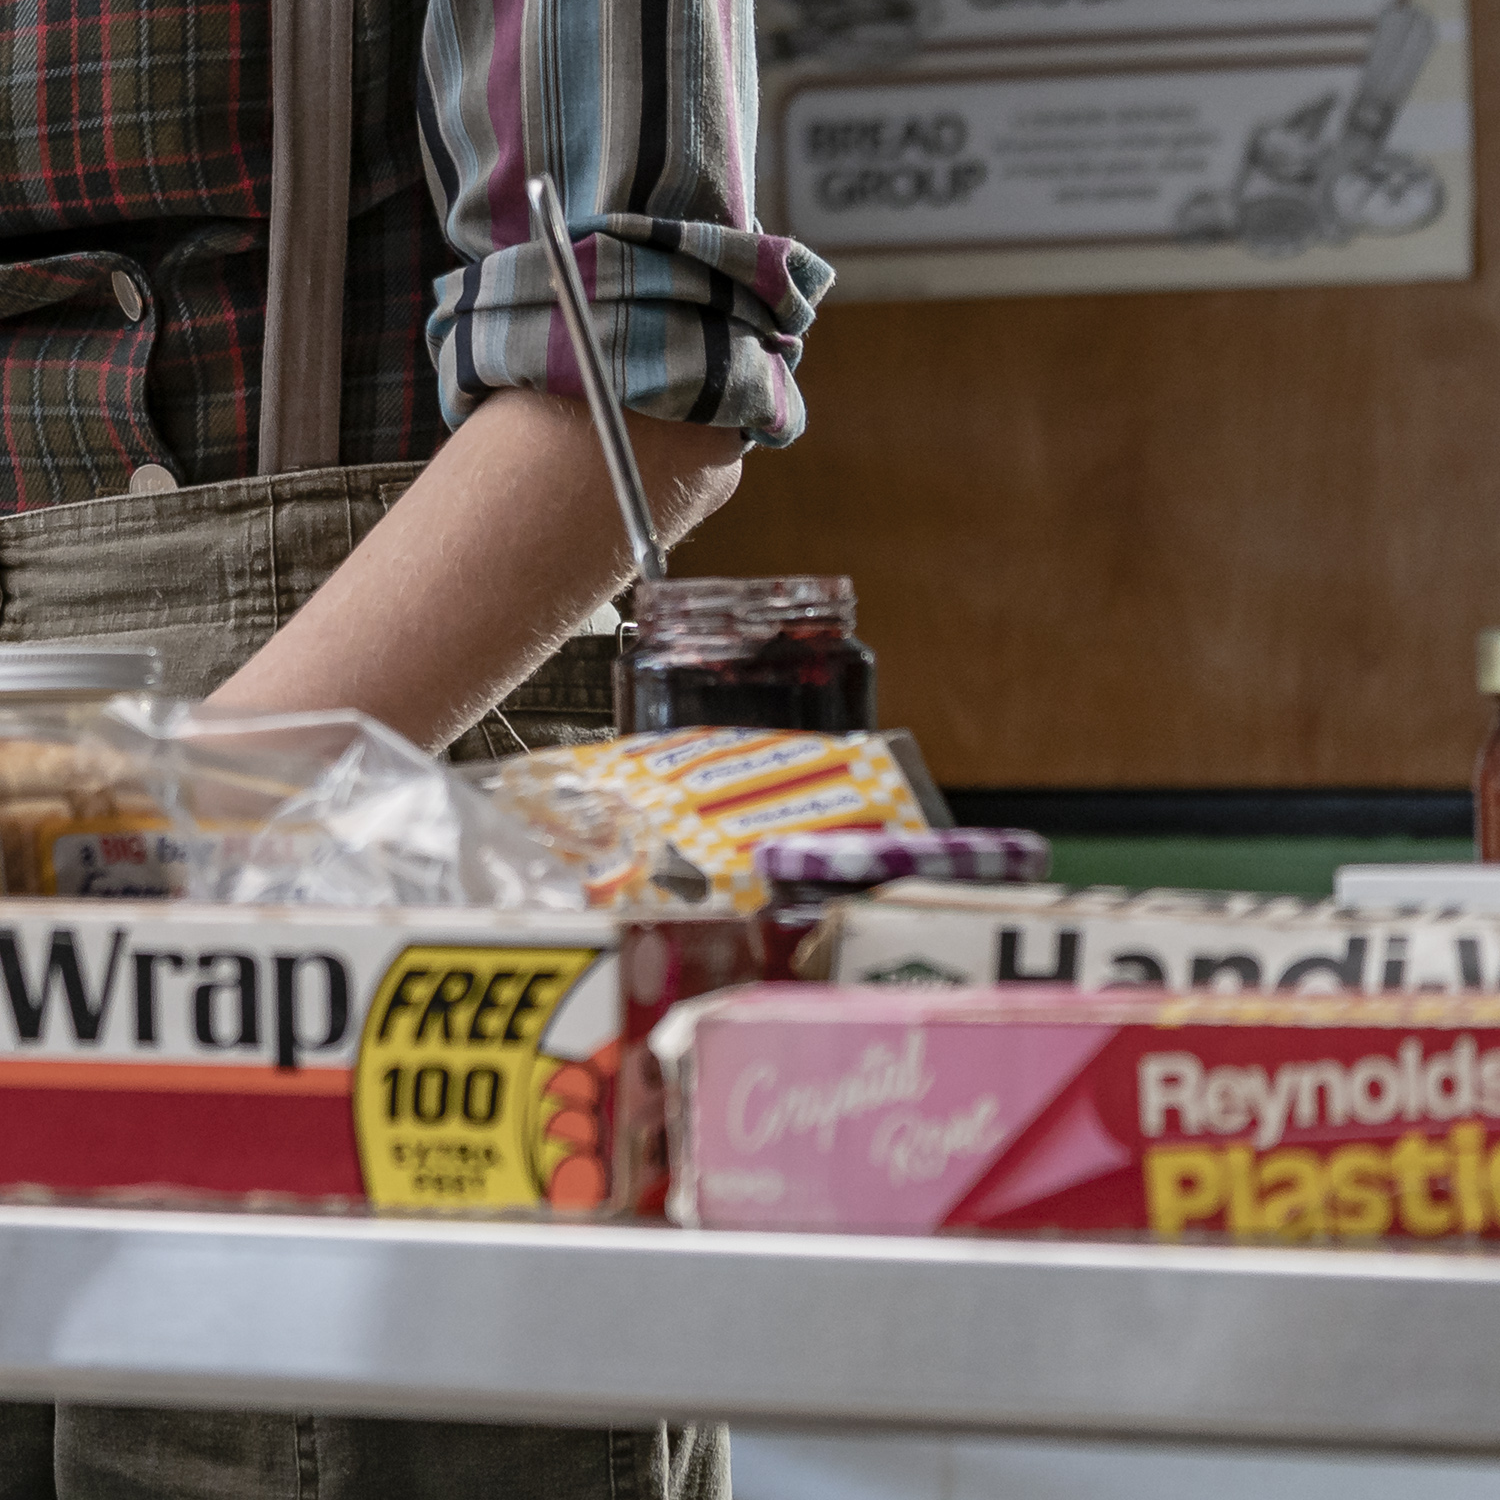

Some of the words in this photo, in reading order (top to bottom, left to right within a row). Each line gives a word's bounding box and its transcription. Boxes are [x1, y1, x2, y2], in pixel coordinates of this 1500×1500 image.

[817, 161, 989, 212] GROUP
[376, 970, 558, 1044] FREE
[382, 1067, 502, 1126] 100
